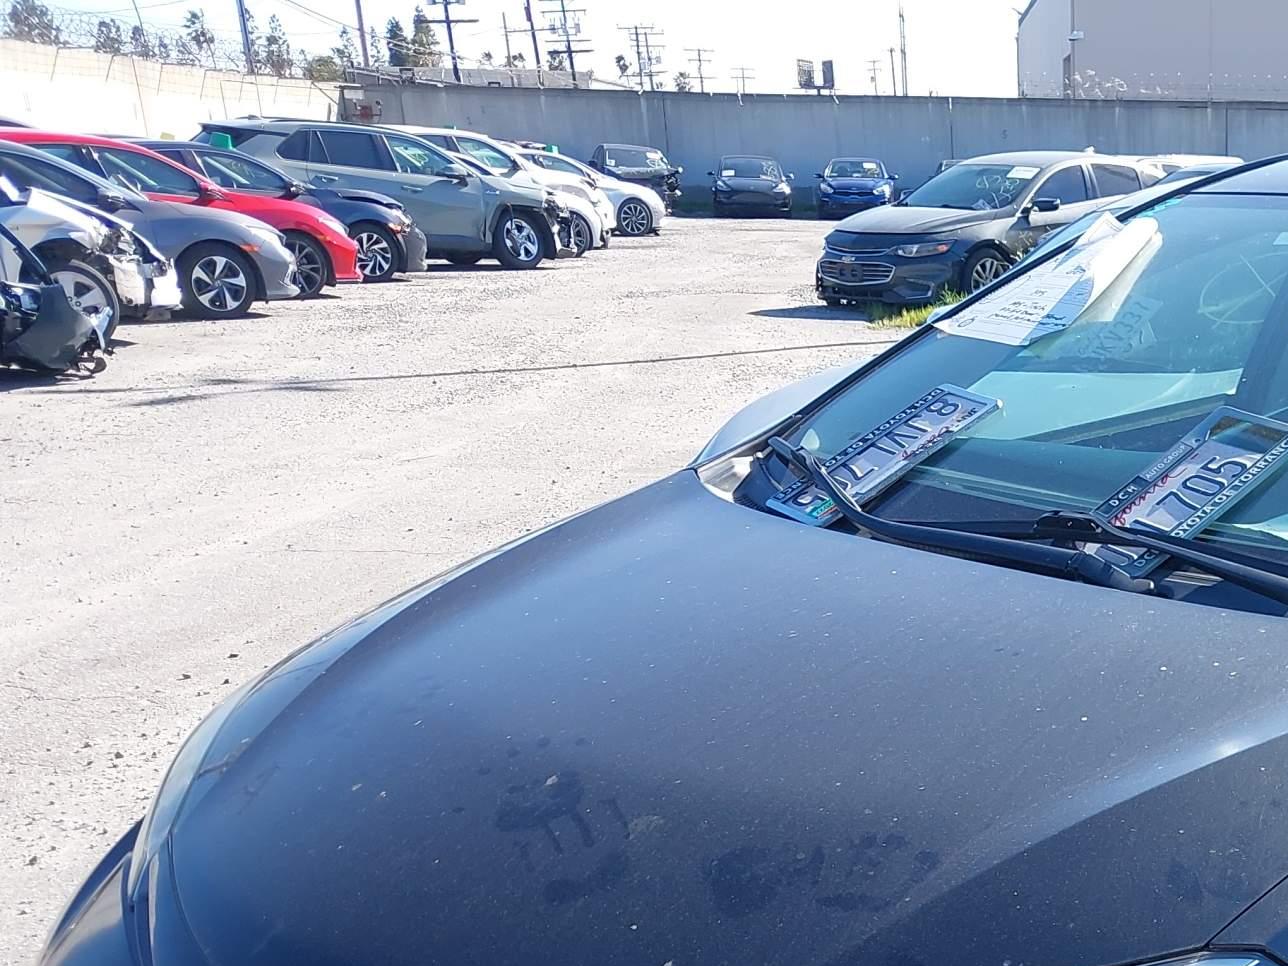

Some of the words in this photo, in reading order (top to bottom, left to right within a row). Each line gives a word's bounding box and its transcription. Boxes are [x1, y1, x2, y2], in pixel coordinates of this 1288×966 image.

[862, 403, 920, 442] TOYOTA
[845, 439, 864, 455] OF
[1109, 485, 1138, 508] DCH
[1145, 460, 1166, 481] AUTO
[1163, 443, 1188, 465] GROUP
[1171, 502, 1216, 538] OYOTA
[1215, 487, 1235, 504] OF
